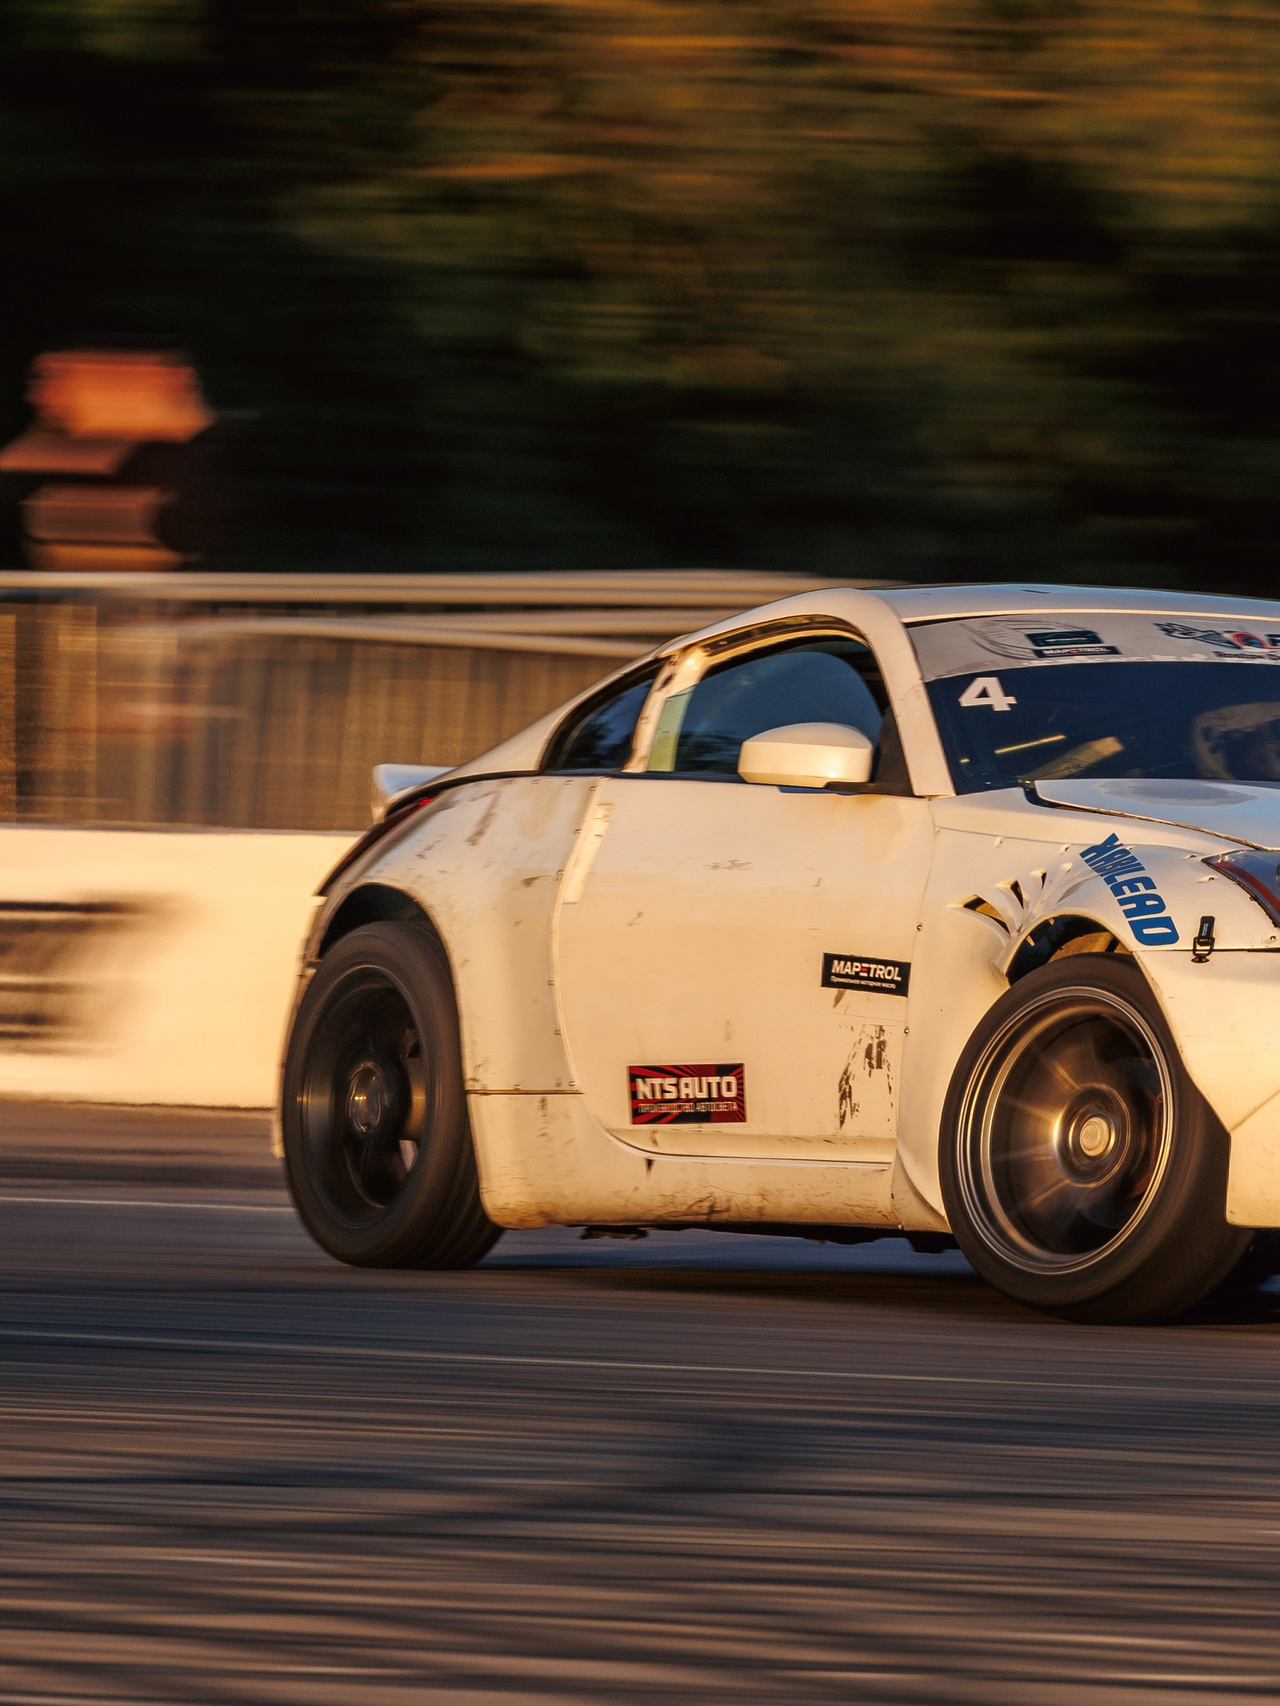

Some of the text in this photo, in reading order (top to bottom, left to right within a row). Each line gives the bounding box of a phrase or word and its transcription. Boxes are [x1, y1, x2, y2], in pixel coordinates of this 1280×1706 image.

[958, 677, 1017, 711] 4
[1079, 833, 1179, 946] XABILEAD
[831, 960, 902, 981] MAPETROL
